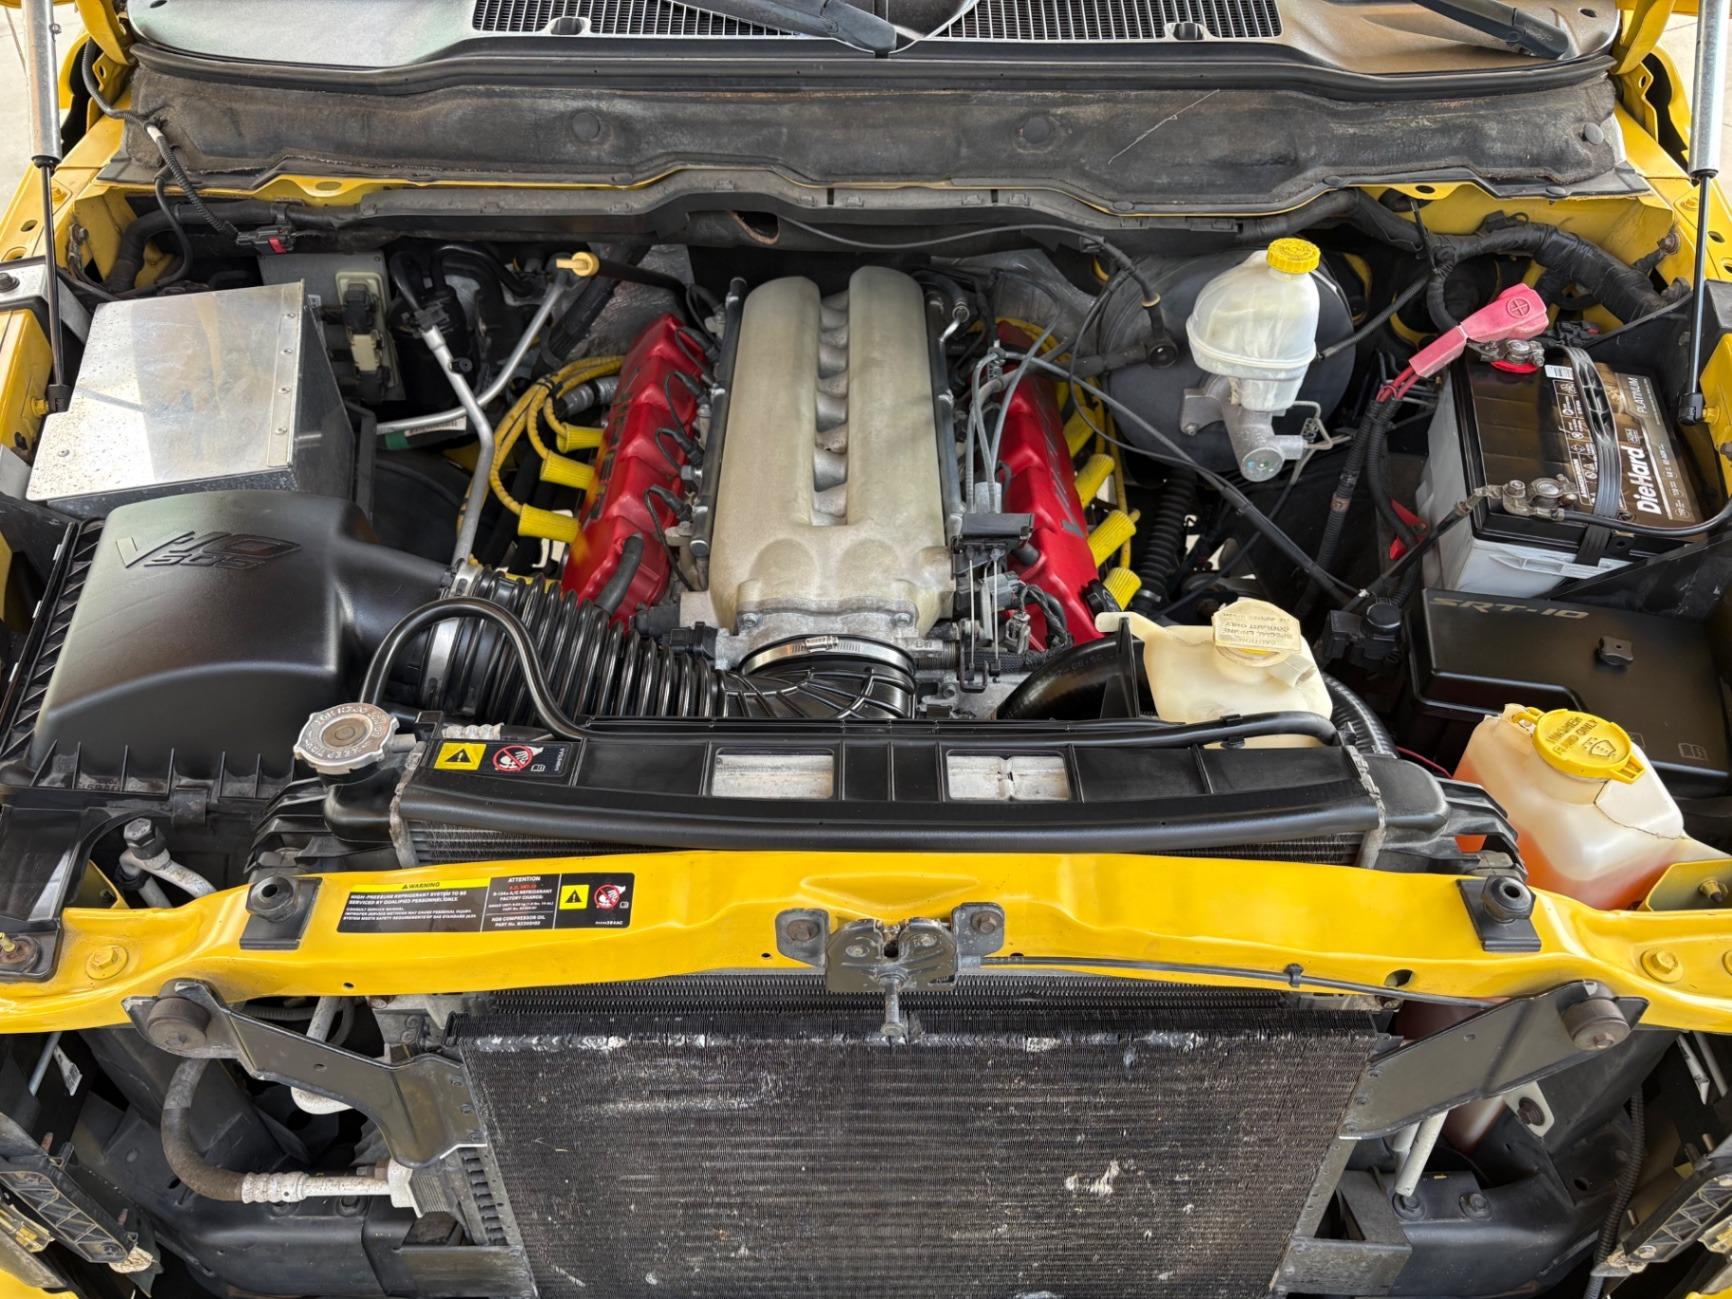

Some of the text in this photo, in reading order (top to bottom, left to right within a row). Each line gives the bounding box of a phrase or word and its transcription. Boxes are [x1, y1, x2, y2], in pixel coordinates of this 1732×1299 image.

[1628, 377, 1648, 414] PLATINUM
[1621, 445, 1663, 516] DieHard
[144, 553, 266, 570] 505
[1429, 597, 1590, 620] SRT-10
[1575, 719, 1598, 736] ONLY
